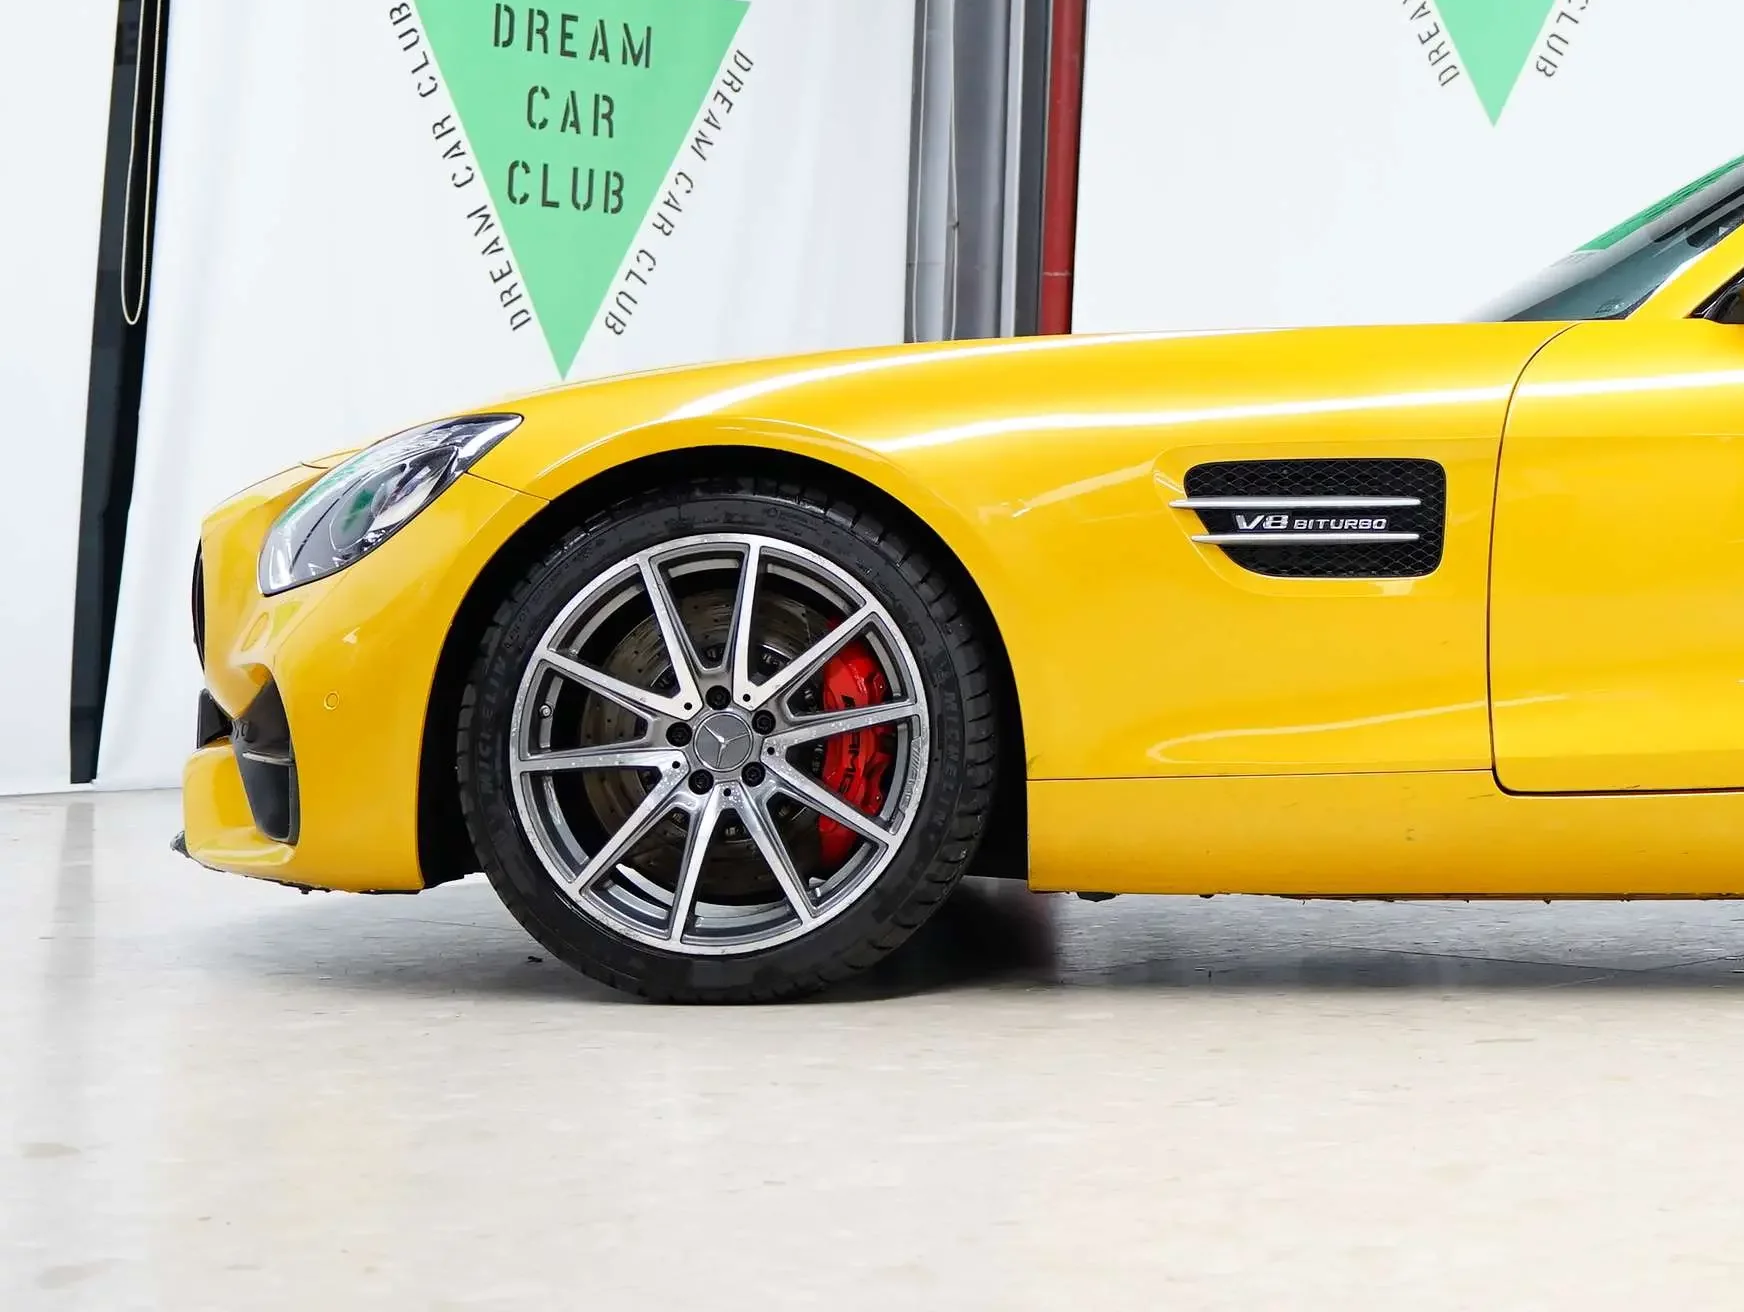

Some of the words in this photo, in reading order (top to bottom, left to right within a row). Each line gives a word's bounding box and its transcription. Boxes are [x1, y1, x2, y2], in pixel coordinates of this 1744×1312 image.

[389, 2, 438, 98] CLUB
[493, 3, 653, 69] DREAM
[526, 85, 615, 138] CAR
[690, 49, 754, 161] DREAM
[432, 114, 474, 189] CAR
[507, 160, 625, 215] CLUB
[652, 171, 695, 237] CAR
[467, 204, 532, 331] DREAM
[604, 248, 656, 336] CLUB
[1235, 514, 1289, 531] V8
[1293, 517, 1387, 530] BITURBO
